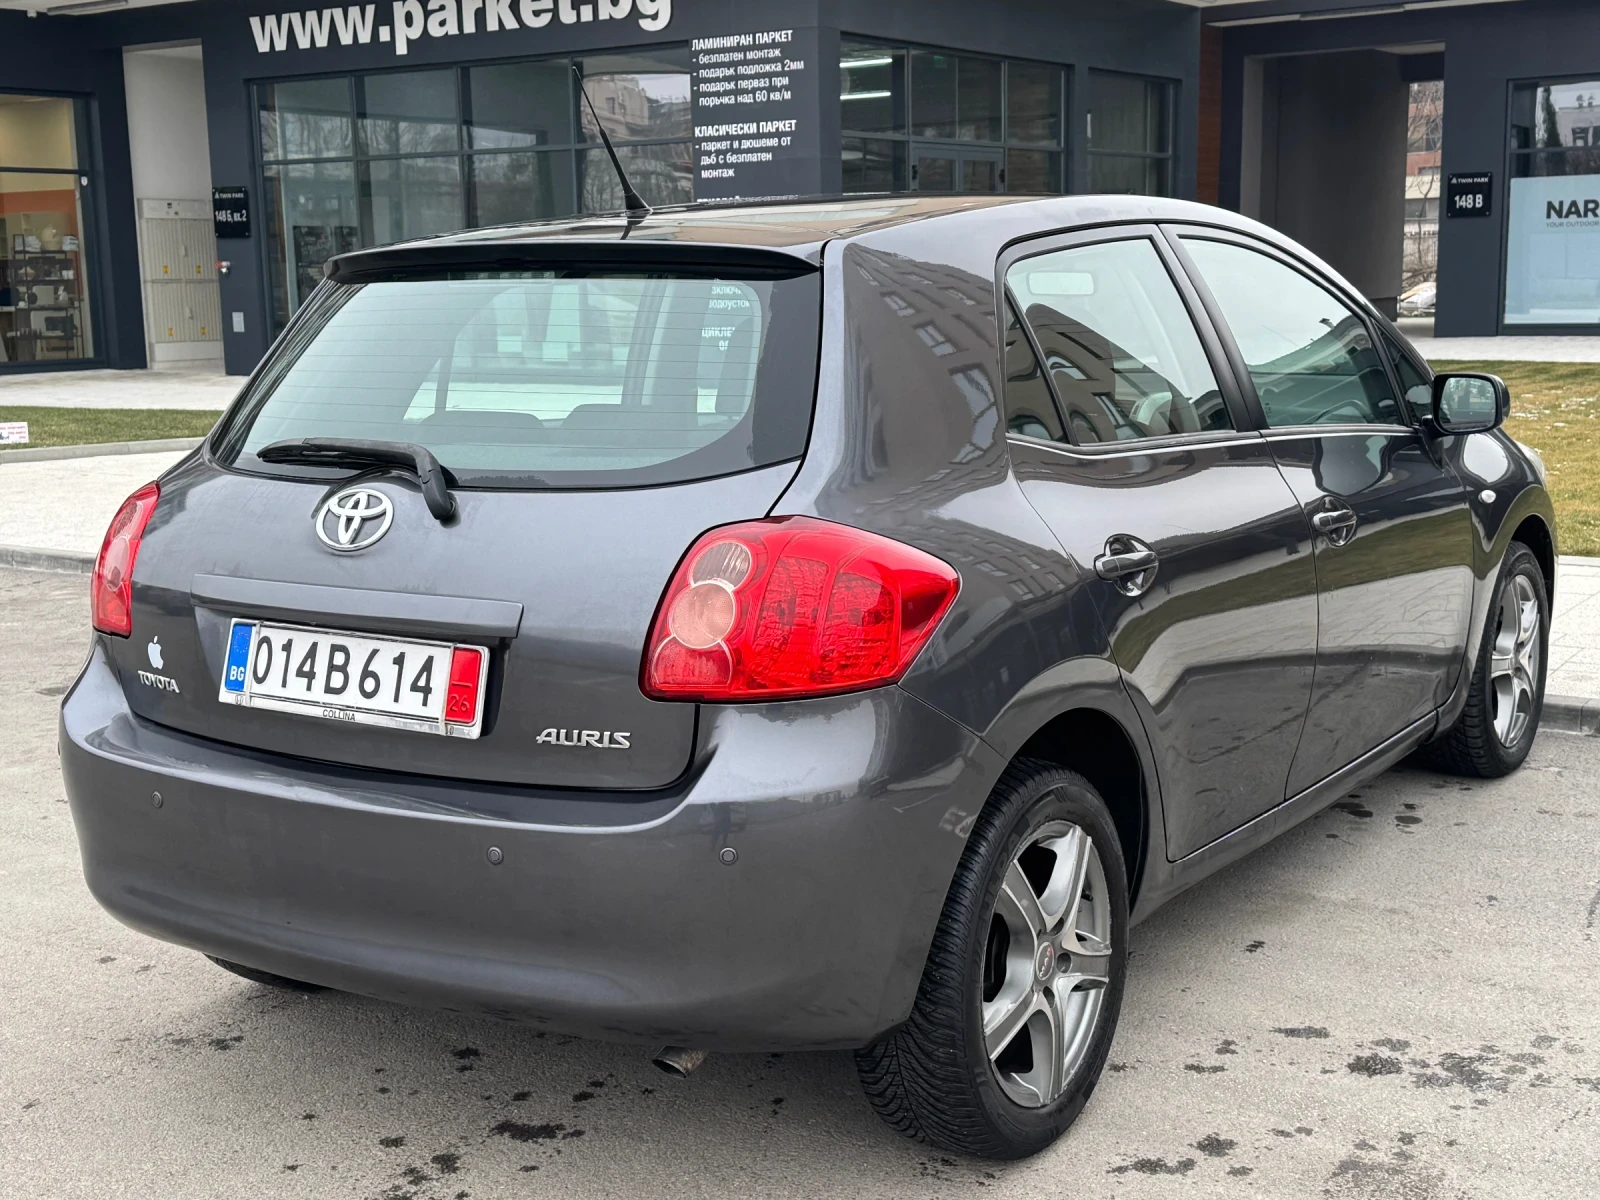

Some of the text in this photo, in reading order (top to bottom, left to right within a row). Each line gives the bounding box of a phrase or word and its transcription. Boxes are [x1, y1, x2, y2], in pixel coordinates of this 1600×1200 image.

[692, 30, 793, 51] ЛАМИНИРАН ПАРКЕТ
[698, 52, 744, 64] безплатен
[746, 48, 781, 60] монтаж
[699, 67, 735, 78] подарък
[737, 63, 782, 75] подложка
[784, 59, 804, 71] 2мм
[699, 81, 736, 92] подарък
[737, 79, 769, 90] перваз
[771, 76, 789, 88] при
[699, 88, 791, 107] поръчка над 60 кв/м
[694, 120, 797, 137] КЛАСИЧЕСКИ ПАРКЕТ
[701, 140, 731, 152] паркет
[732, 140, 739, 149] и
[740, 137, 779, 149] дюшеме
[780, 136, 792, 146] от
[700, 151, 773, 165] дъб с безплатен
[701, 168, 735, 178] монтаж
[1454, 194, 1474, 209] 148
[1545, 199, 1600, 219] NAR
[1546, 219, 1600, 228] YOUR OUTDOOR
[701, 326, 735, 338] ЦИКЛЕ
[229, 665, 245, 681] BG
[252, 635, 435, 707] 014B614
[137, 670, 180, 693] TOYOTA
[448, 693, 470, 712] 26
[322, 708, 356, 721] COLLINA
[535, 728, 631, 749] AURIS
